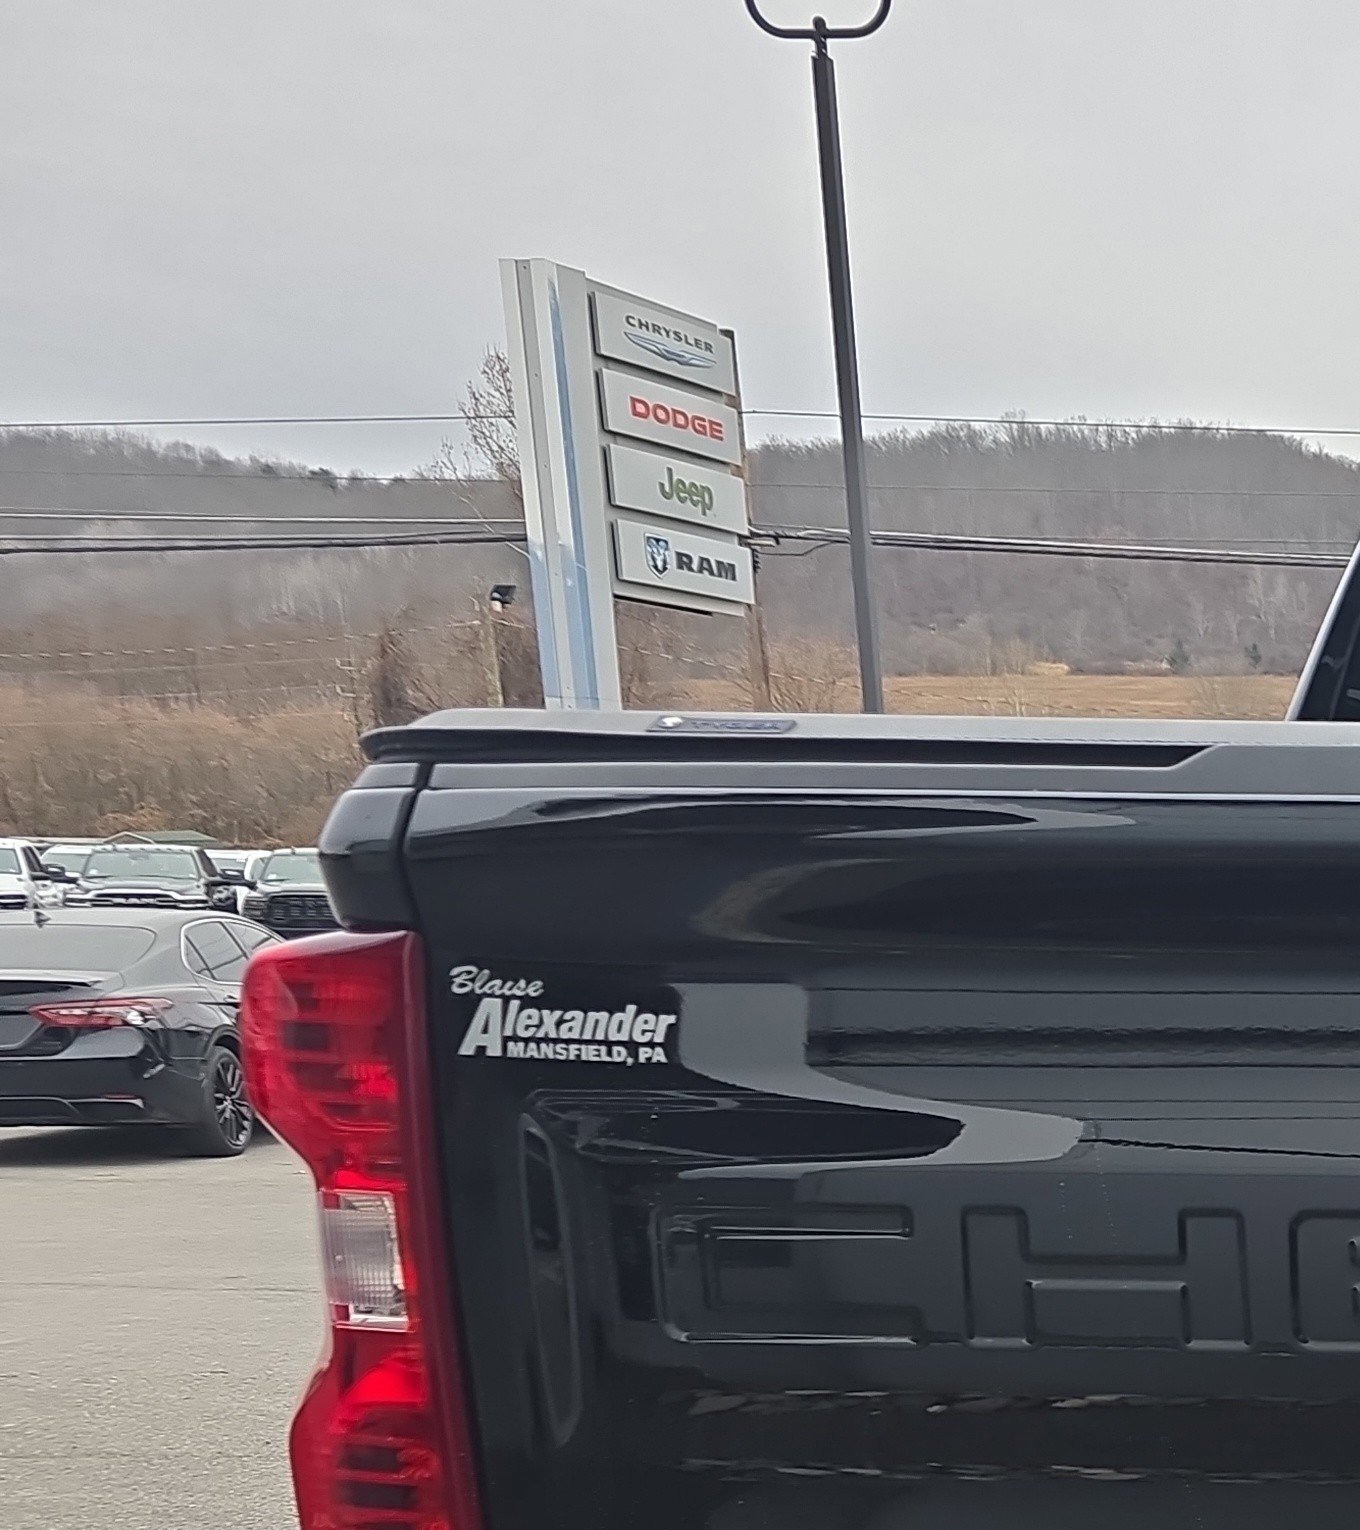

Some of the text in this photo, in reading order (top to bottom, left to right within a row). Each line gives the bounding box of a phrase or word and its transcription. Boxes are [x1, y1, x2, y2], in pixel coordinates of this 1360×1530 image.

[625, 315, 715, 354] CHRYSLER
[628, 395, 725, 441] DODGE
[658, 466, 714, 516] Jeep
[674, 550, 738, 582] RAM
[449, 965, 545, 998] Blaise
[457, 997, 678, 1058] Alexander
[506, 1040, 669, 1067] MANSFIELD, PA
